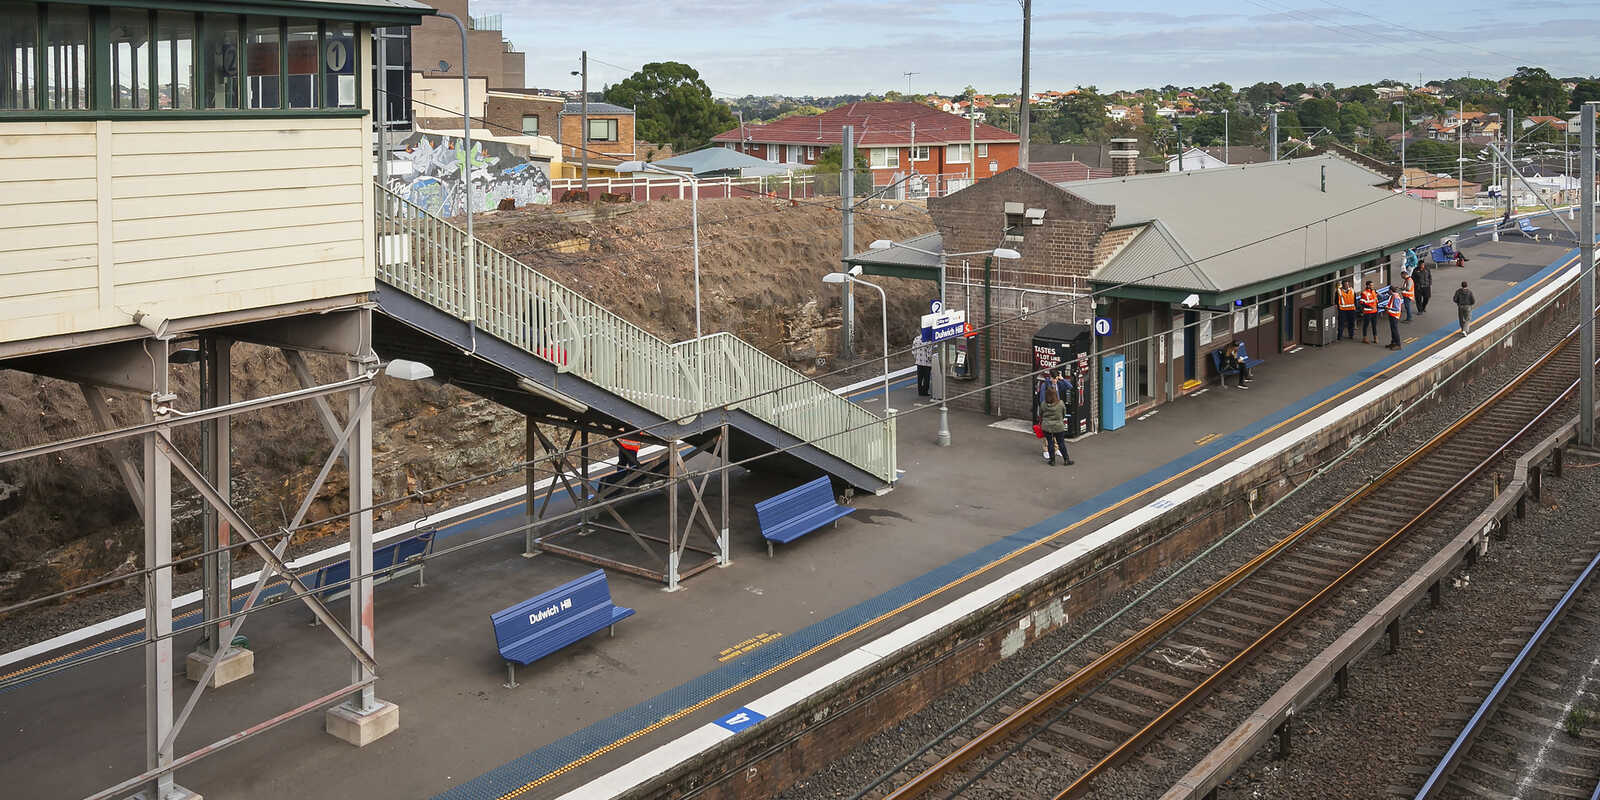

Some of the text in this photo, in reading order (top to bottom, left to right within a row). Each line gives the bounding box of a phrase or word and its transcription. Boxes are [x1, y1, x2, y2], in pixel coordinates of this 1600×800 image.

[934, 325, 964, 340] Dulwich Hill
[1034, 346, 1056, 354] TASTES
[1040, 360, 1057, 368] COKE
[529, 598, 572, 624] Dulwich Hill
[725, 712, 751, 725] 4
